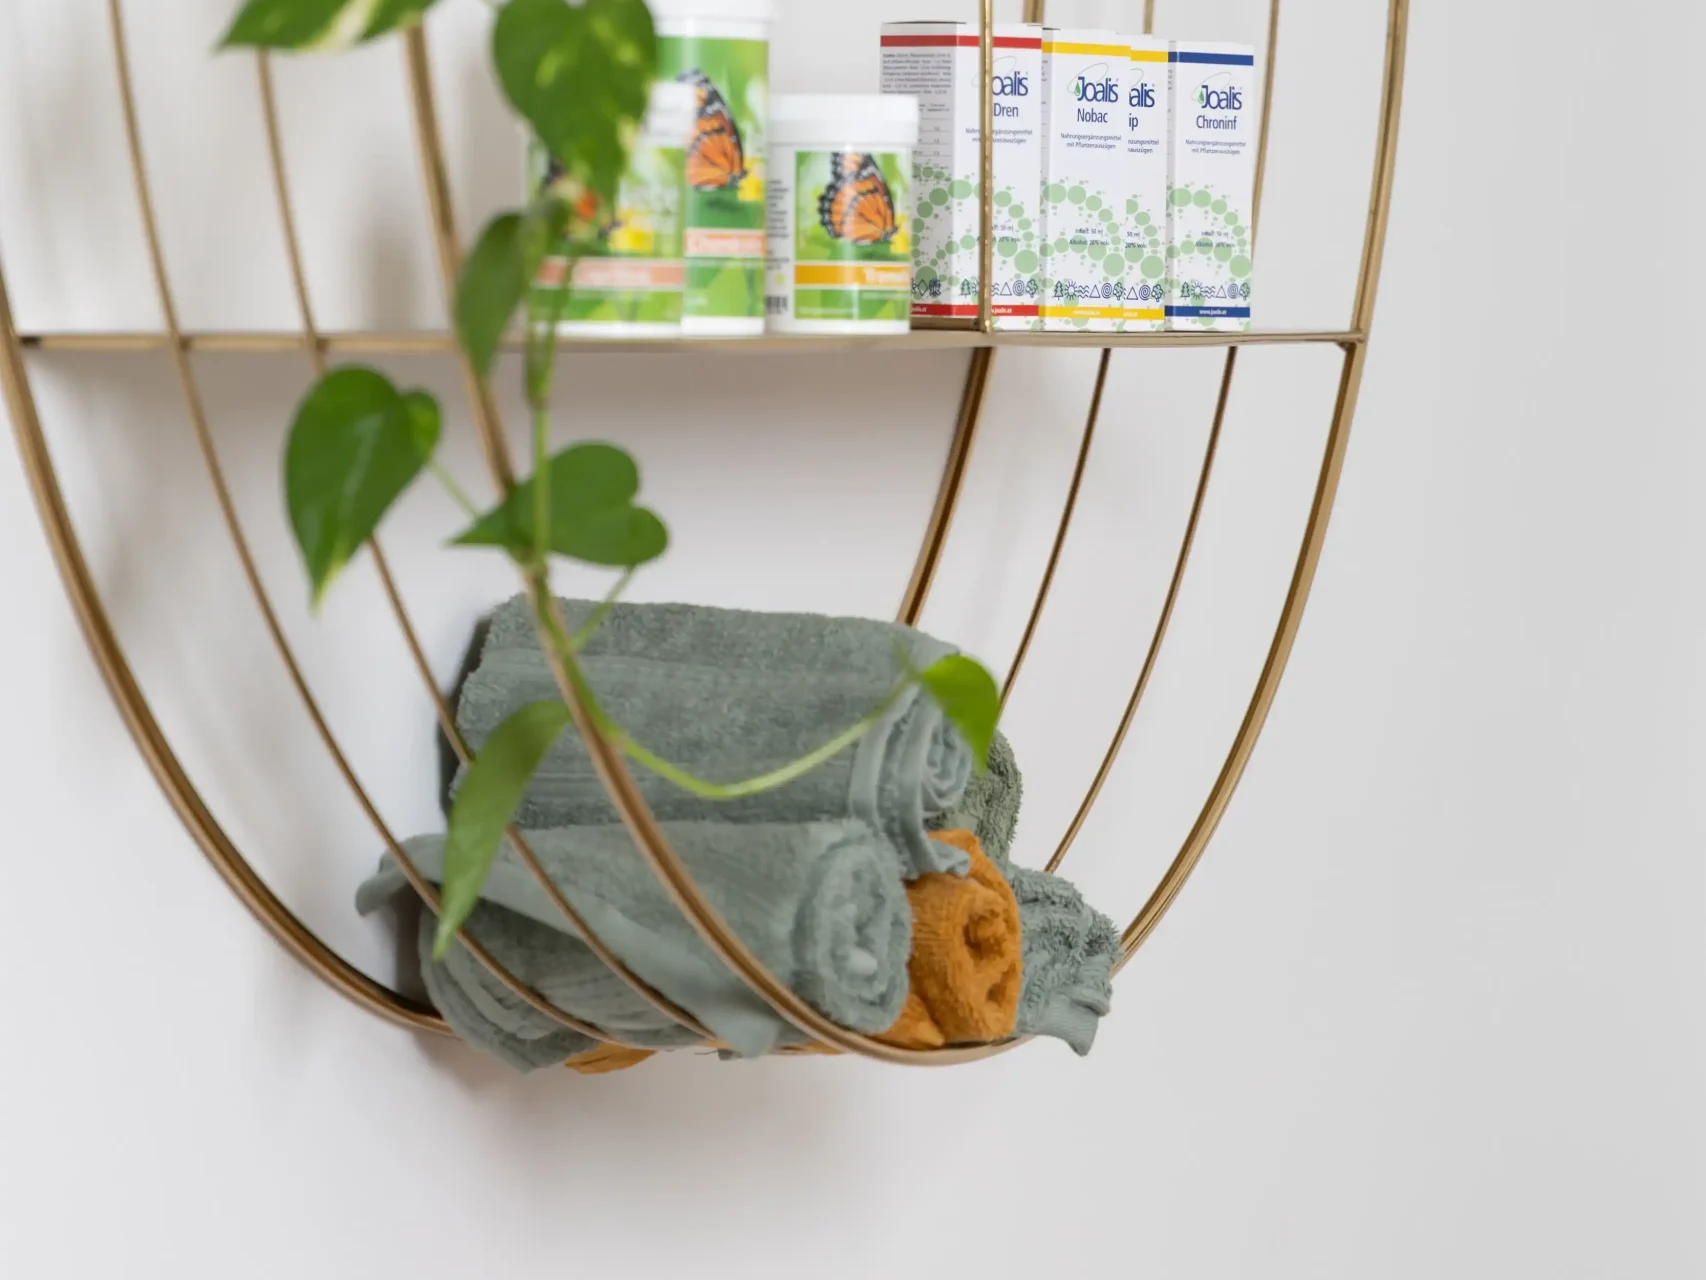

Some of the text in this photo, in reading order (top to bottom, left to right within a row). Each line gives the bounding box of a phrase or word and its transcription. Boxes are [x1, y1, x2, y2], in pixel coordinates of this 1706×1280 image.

[990, 70, 1029, 96] oalis
[1077, 76, 1119, 103] Joalis
[1129, 83, 1155, 108] alis
[1201, 85, 1242, 110] Joalis
[1077, 108, 1108, 123] Nobac
[1196, 115, 1237, 130] Chroninf
